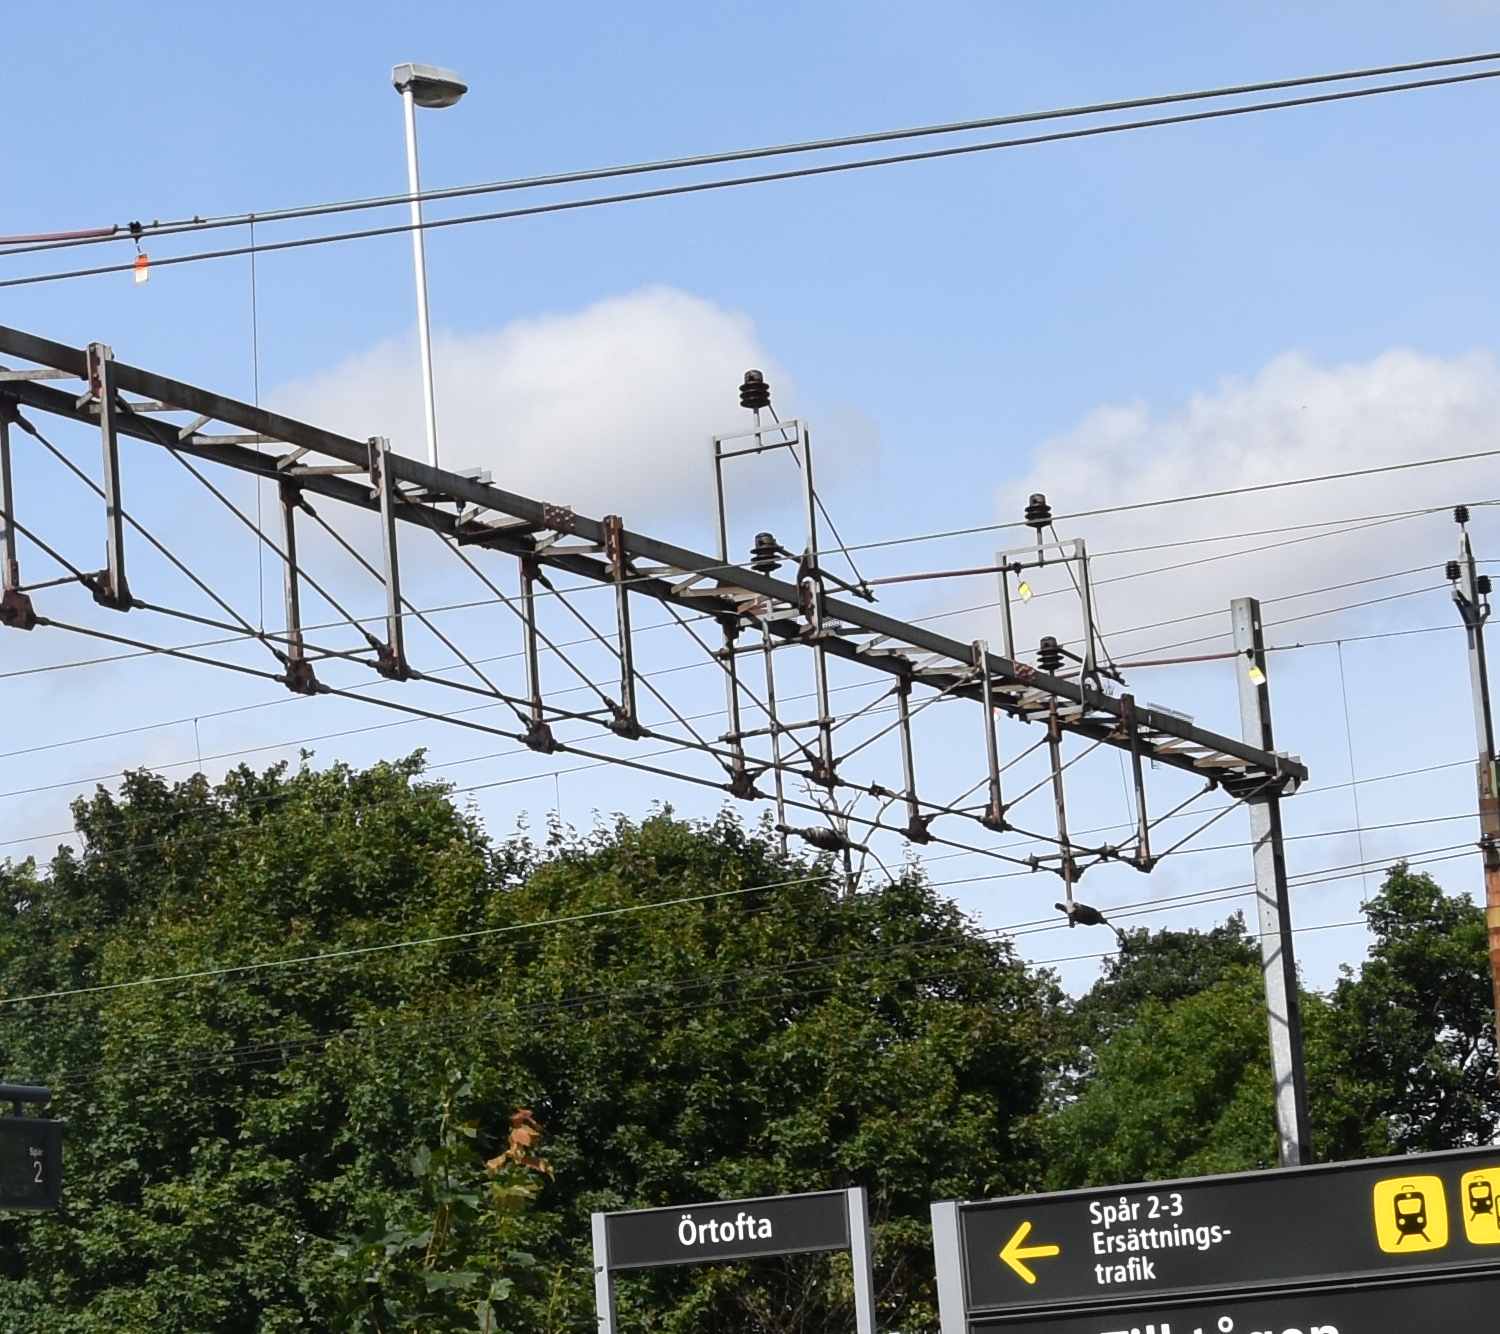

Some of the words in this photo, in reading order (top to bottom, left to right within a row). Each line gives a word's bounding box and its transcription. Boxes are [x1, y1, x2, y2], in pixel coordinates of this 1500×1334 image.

[33, 1160, 43, 1183] 2
[1089, 1196, 1140, 1229] Spår
[1147, 1193, 1183, 1219] 2-3
[678, 1212, 773, 1247] Örtofta
[1092, 1223, 1232, 1255] Ersättnings-
[1094, 1255, 1157, 1285] trafik
